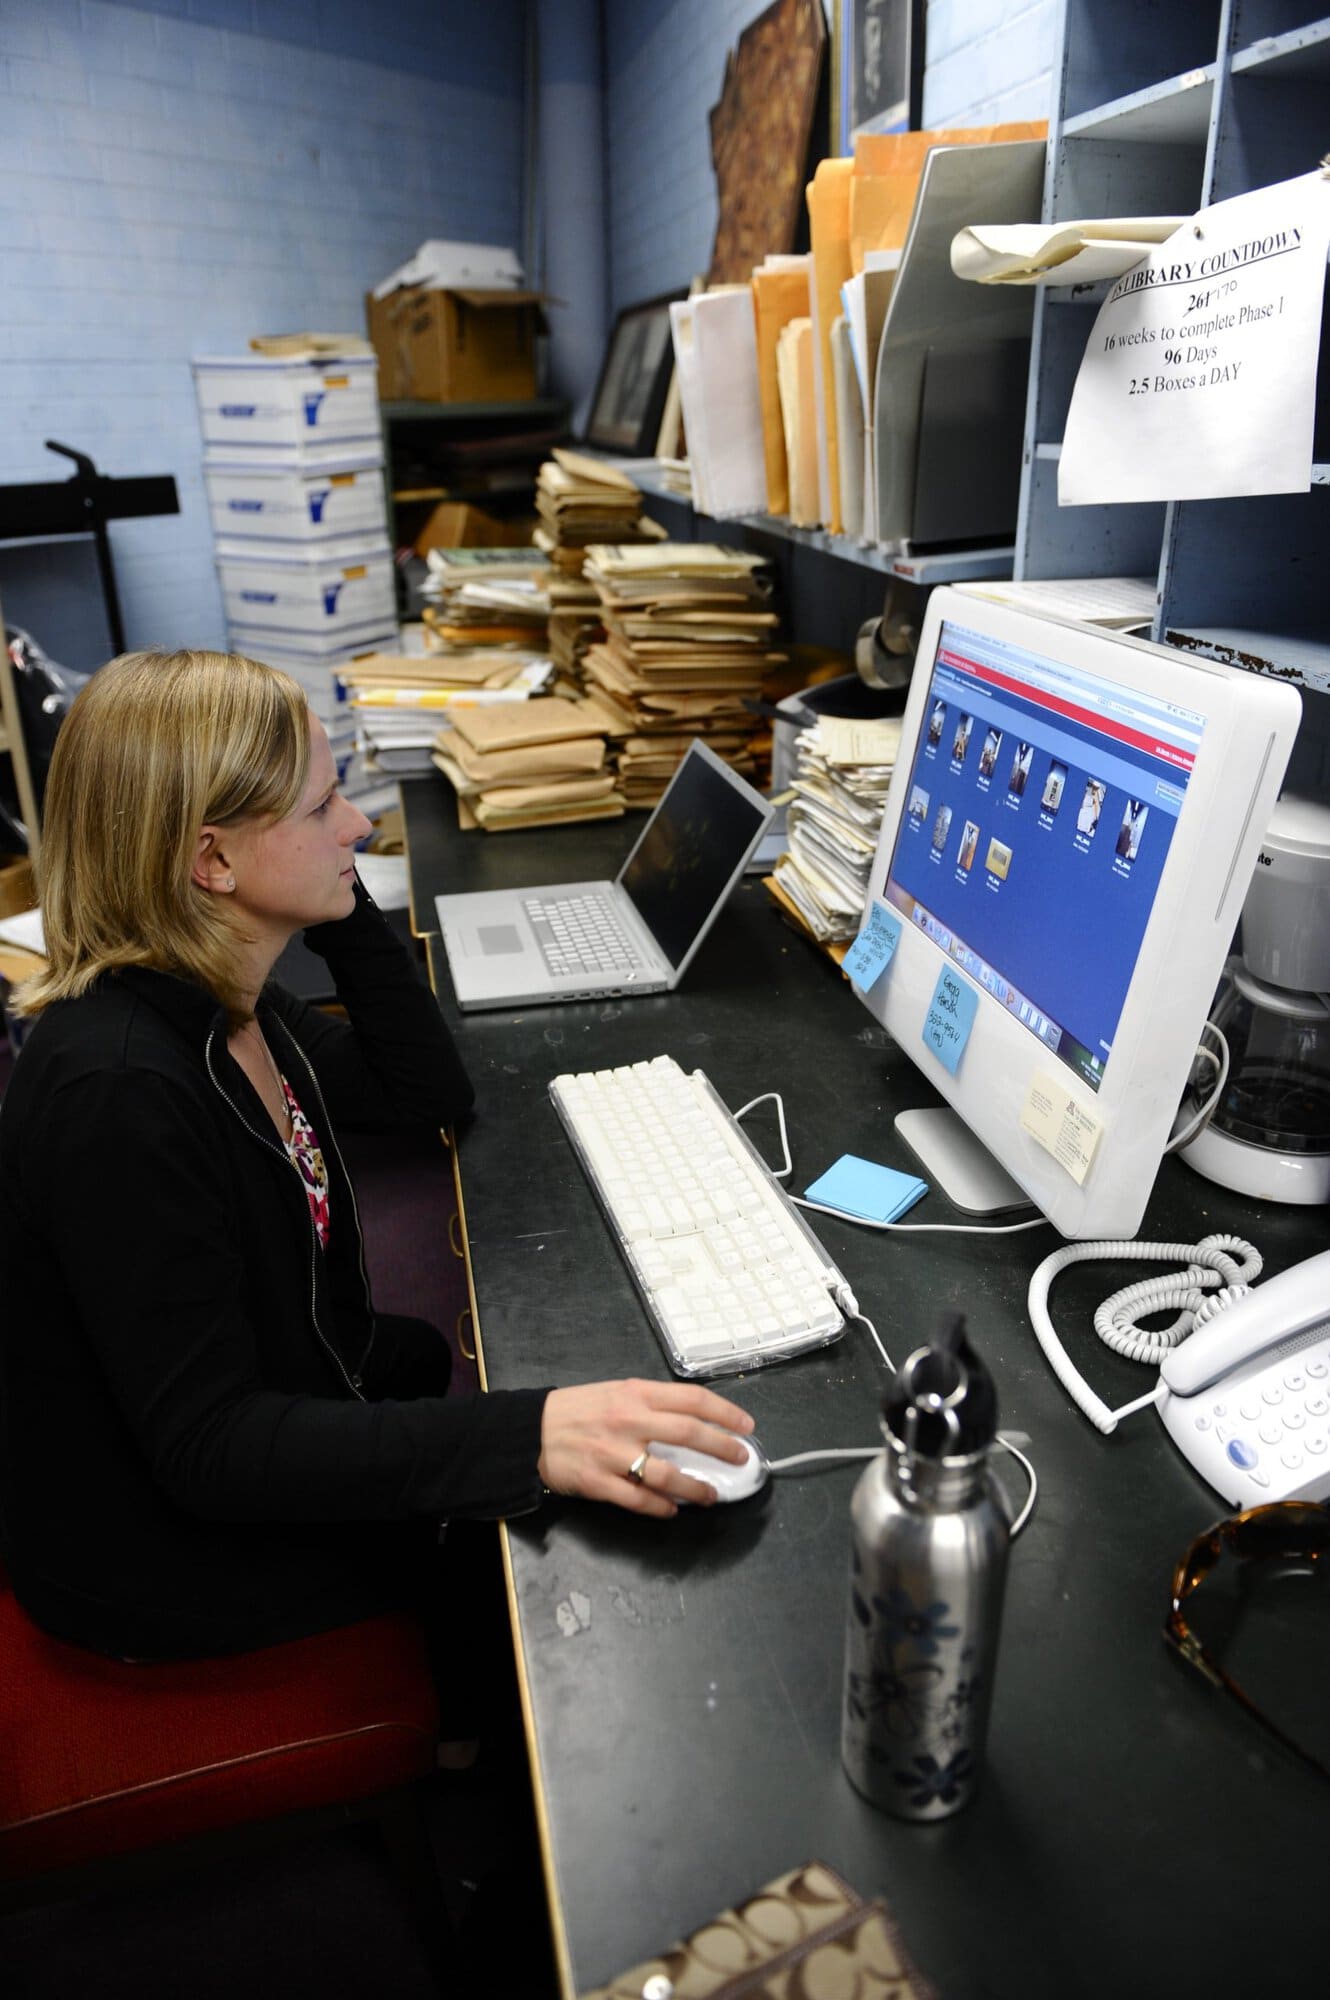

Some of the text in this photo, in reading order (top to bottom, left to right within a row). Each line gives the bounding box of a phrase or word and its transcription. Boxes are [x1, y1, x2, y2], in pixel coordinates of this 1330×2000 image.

[1123, 262, 1196, 293] LIBRARY
[1201, 226, 1303, 275] COUNTDOWN
[1104, 333, 1116, 351] 16
[1119, 328, 1156, 347] weeks
[1161, 326, 1175, 341] to
[1180, 313, 1236, 339] complete
[1239, 302, 1274, 325] Phase
[1164, 345, 1218, 366] 96 Days
[1128, 362, 1242, 395] 2.5 Boxes a DAY
